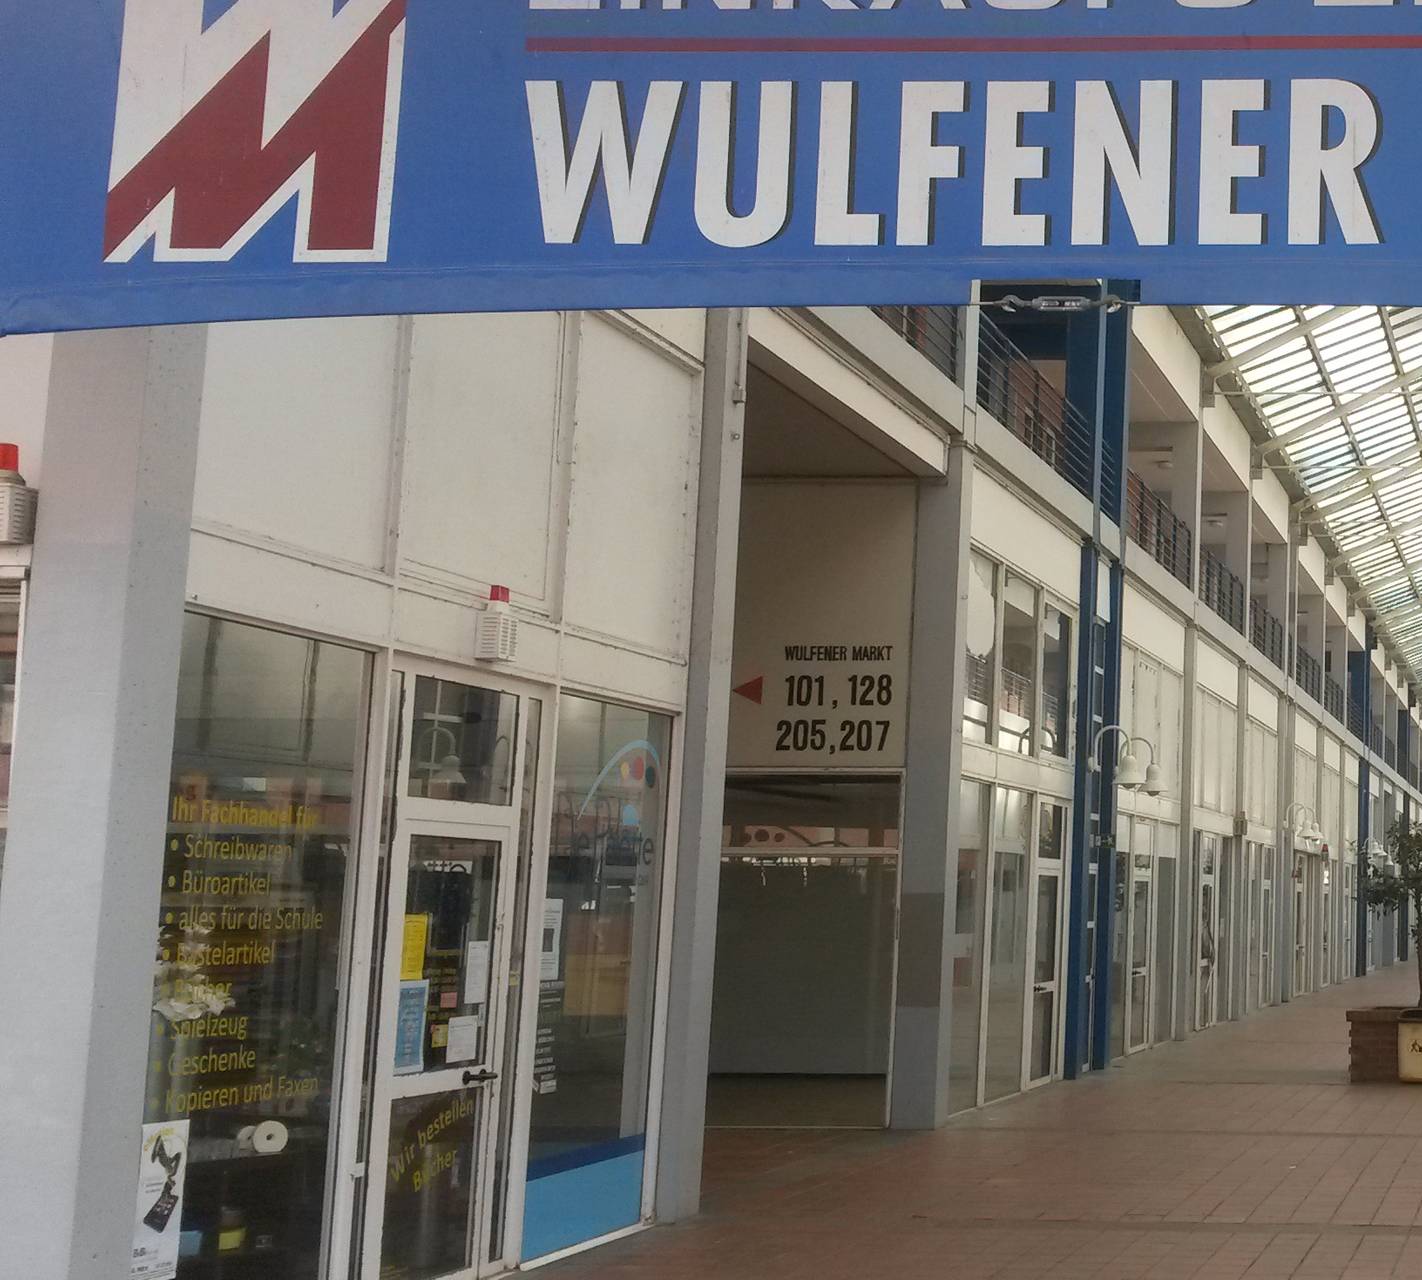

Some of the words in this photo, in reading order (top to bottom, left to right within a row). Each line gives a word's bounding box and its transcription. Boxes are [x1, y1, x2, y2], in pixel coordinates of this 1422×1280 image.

[524, 78, 1385, 248] WULFENER
[784, 645, 848, 662] WULFENER
[852, 645, 893, 661] MARKT
[847, 673, 893, 706] 128
[172, 795, 195, 823] Ihr
[201, 799, 293, 827] Fachhandel
[183, 833, 293, 862] Schreibwaren
[181, 870, 271, 896] Büroartikel
[178, 904, 216, 930] alles
[221, 904, 245, 930] für
[249, 904, 272, 930] die
[275, 905, 324, 931] Schule
[170, 1014, 249, 1041] Spielzeug
[168, 1044, 256, 1077] Geschenke
[165, 1083, 240, 1114] Kopieren
[243, 1076, 273, 1102] und
[277, 1075, 319, 1099] Faxen
[389, 1142, 416, 1184] Wir
[417, 1099, 474, 1148] bestellen
